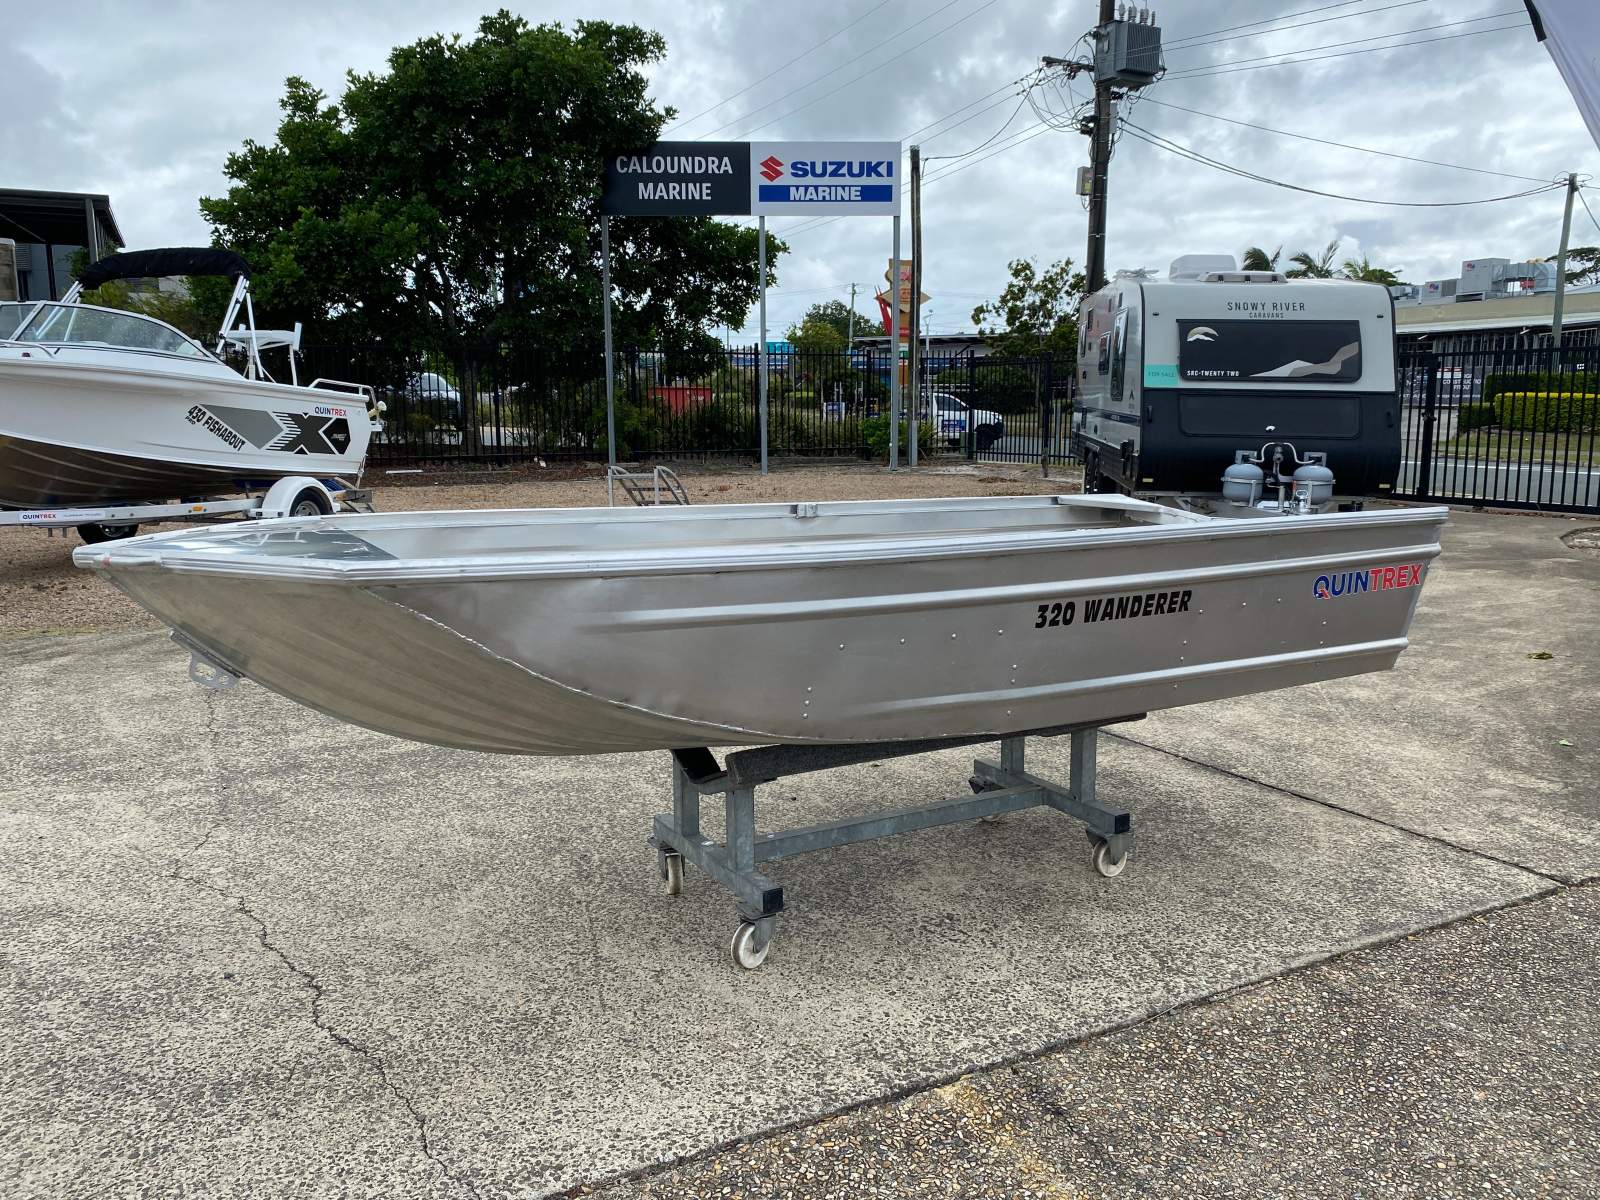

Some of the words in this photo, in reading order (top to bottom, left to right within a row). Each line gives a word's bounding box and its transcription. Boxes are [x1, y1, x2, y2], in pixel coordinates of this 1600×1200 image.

[616, 156, 733, 174] CALOUNDRA
[790, 161, 893, 178] SUZUKI
[638, 182, 712, 200] MARINE
[789, 186, 862, 201] MARINE
[1227, 302, 1266, 311] SNOWY
[1272, 302, 1305, 311] RIVER
[314, 406, 347, 417] QUINTREX
[187, 405, 205, 423] 430
[203, 416, 246, 451] FISHABOUT
[1312, 563, 1422, 599] QUINTREX
[1035, 601, 1075, 628] 320
[1083, 589, 1192, 623] WANDERER
